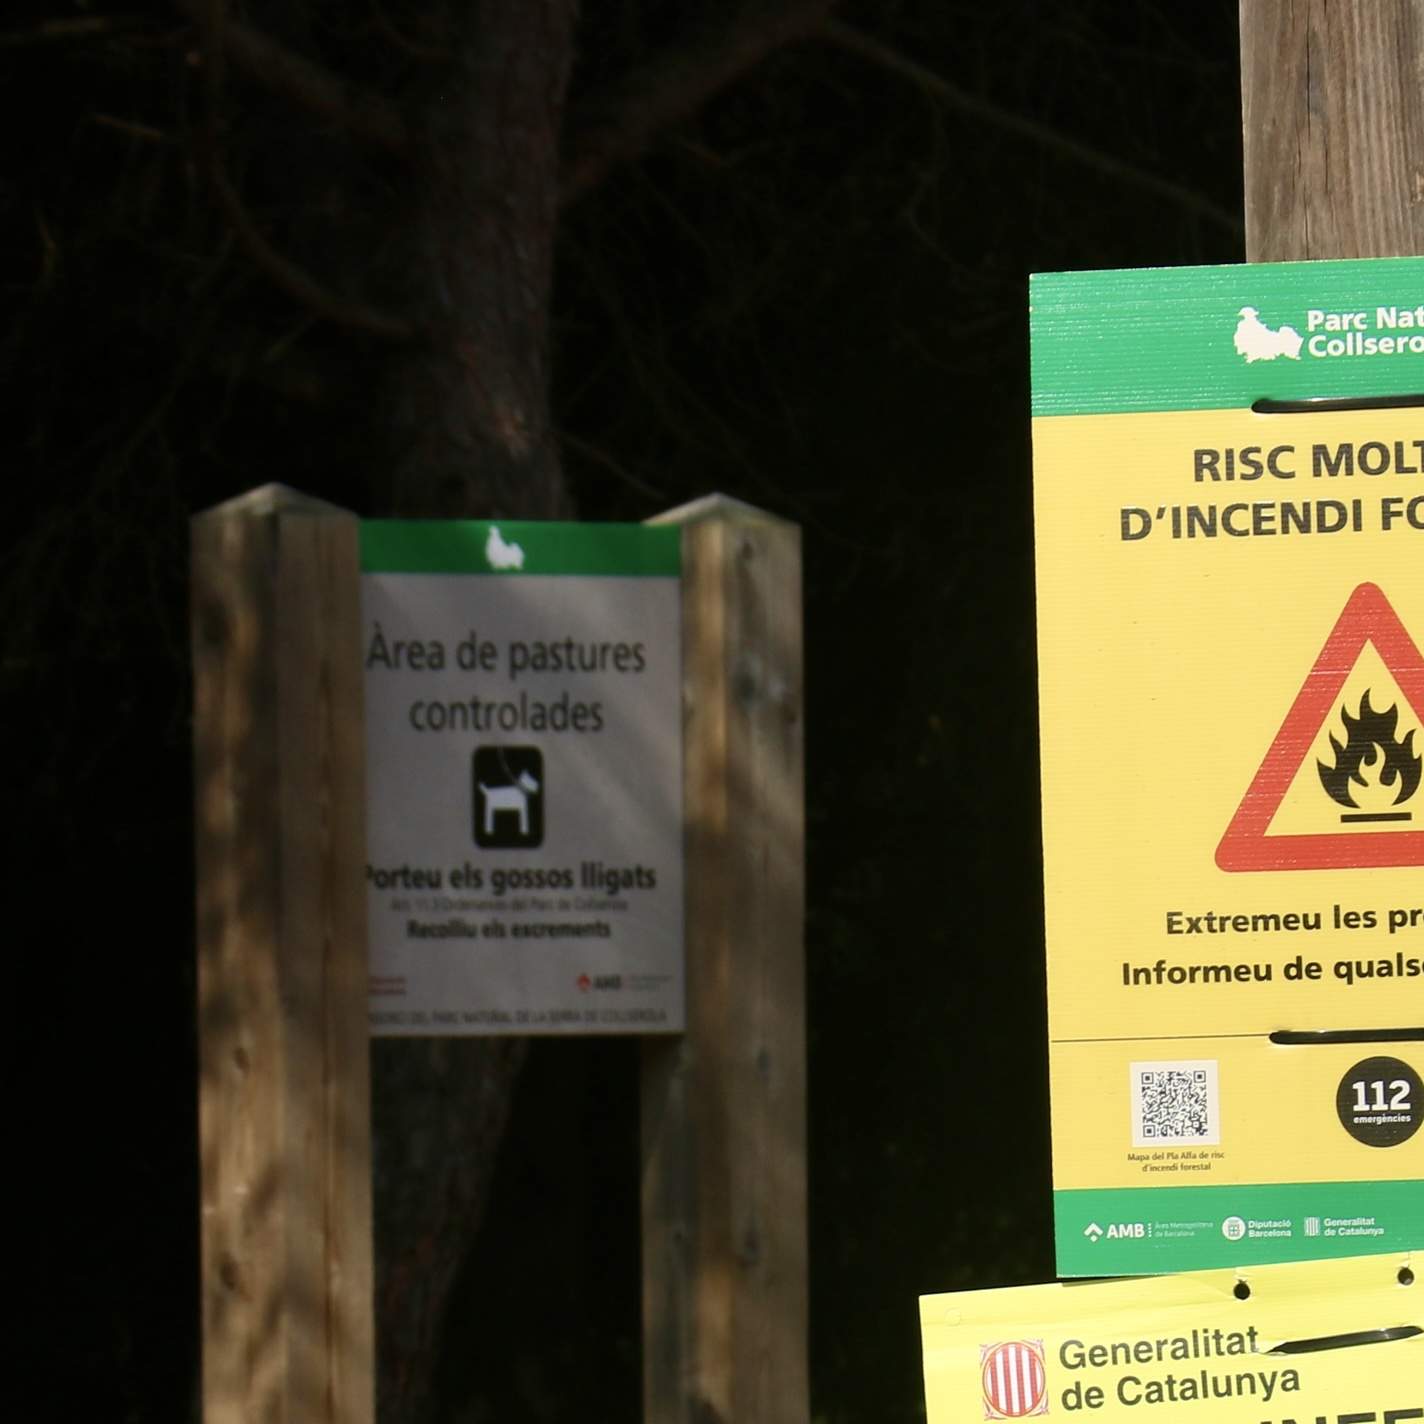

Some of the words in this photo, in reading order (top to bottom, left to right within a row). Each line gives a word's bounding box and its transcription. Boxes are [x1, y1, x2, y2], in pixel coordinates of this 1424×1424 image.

[1308, 310, 1367, 331] Parc
[1194, 446, 1295, 482] RISC
[1121, 499, 1362, 540] D'INCENDI
[456, 630, 498, 671] de
[509, 638, 644, 680] pastures
[409, 695, 603, 732] controlades
[450, 863, 483, 888] els
[491, 869, 573, 896] gossos
[581, 862, 656, 896] lligats
[1167, 912, 1321, 934] Extremeu
[1334, 905, 1377, 929] les
[1123, 960, 1272, 985] Informeu
[1284, 956, 1322, 980] de
[1353, 1080, 1410, 1111] 112
[1354, 1113, 1411, 1124] emergències
[1107, 1224, 1144, 1238] AMB
[1248, 1220, 1291, 1229] Diputació
[1248, 1229, 1291, 1237] Barcelona
[1324, 1218, 1374, 1226] Generalitat
[1324, 1228, 1336, 1236] de
[1338, 1228, 1384, 1236] Catalunya
[1060, 1326, 1258, 1369] Generalitat
[1062, 1381, 1104, 1410] de
[1117, 1370, 1299, 1405] Catalunya
